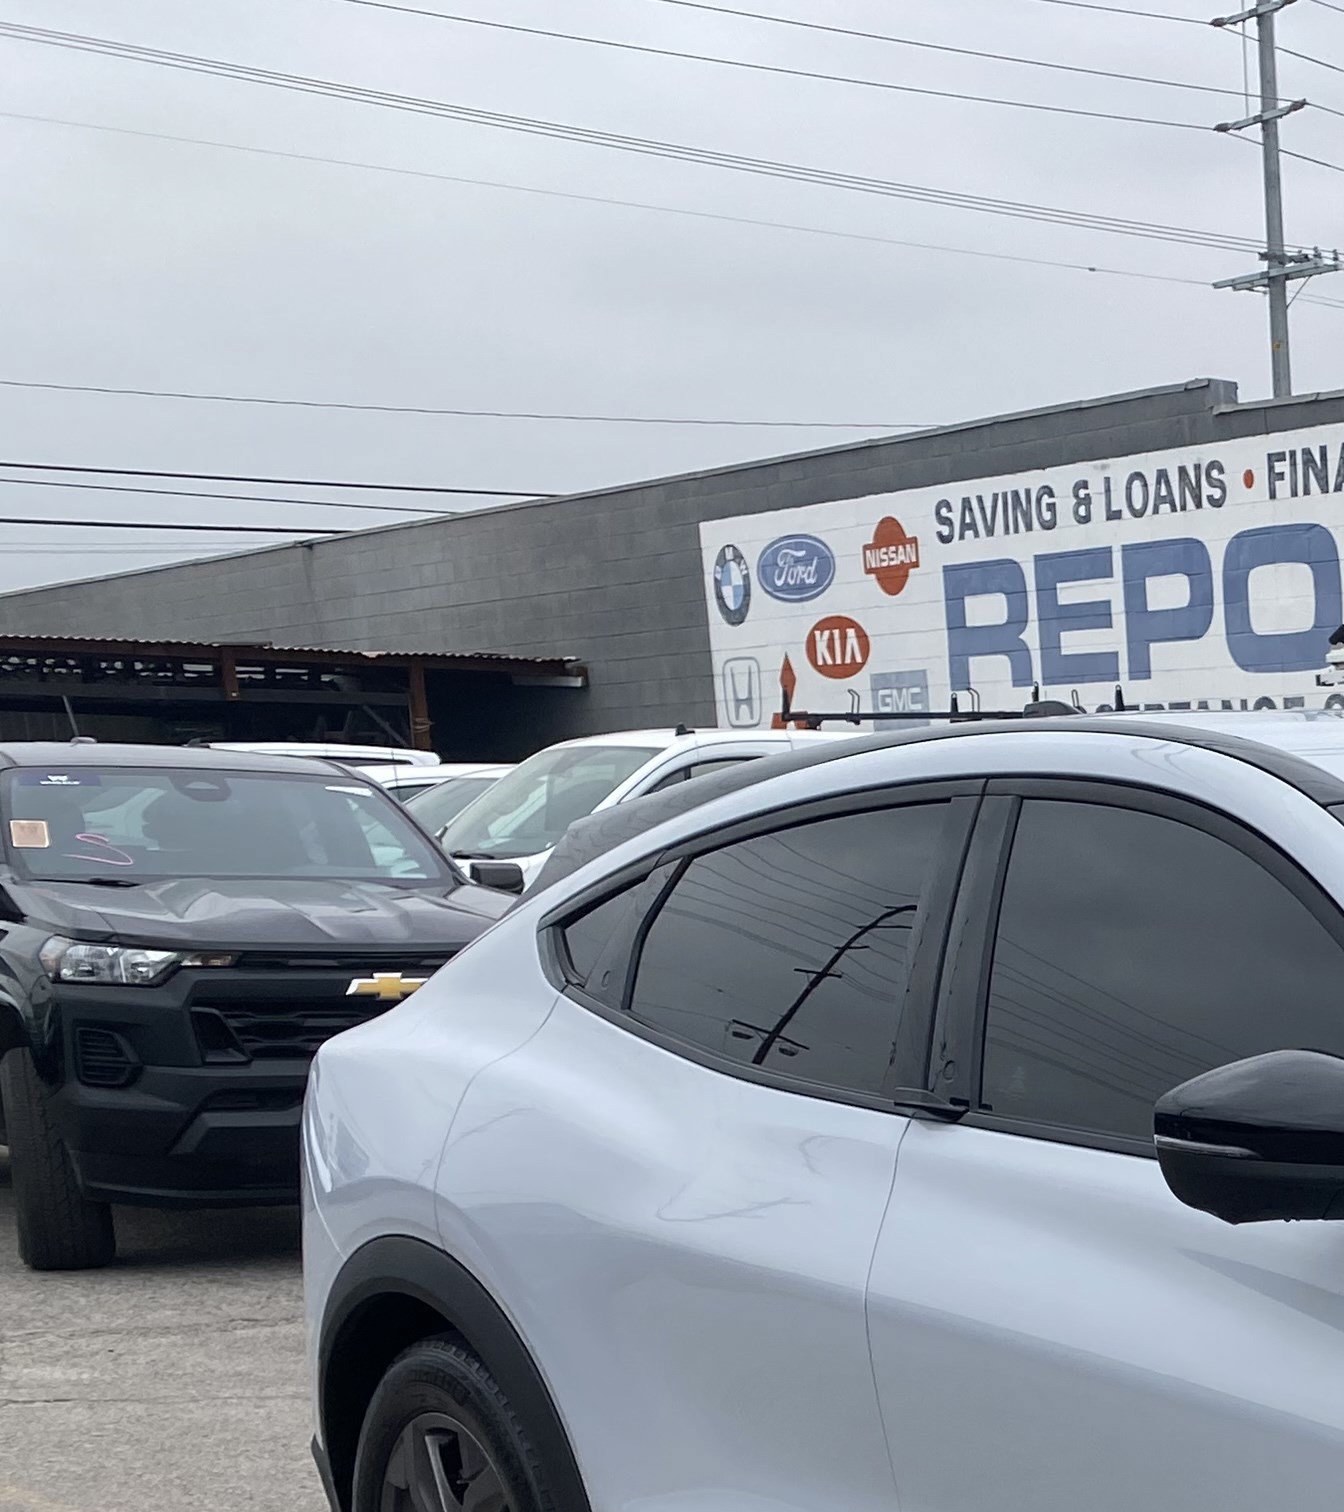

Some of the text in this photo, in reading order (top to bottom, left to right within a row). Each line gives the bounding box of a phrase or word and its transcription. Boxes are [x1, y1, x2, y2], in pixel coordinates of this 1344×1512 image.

[935, 484, 1058, 545] SAVING
[1073, 479, 1092, 525] &
[1104, 459, 1228, 521] LOANS
[774, 548, 819, 587] Ford
[865, 545, 917, 569] NISSAN
[814, 627, 863, 666] KIA
[876, 687, 923, 712] GMC
